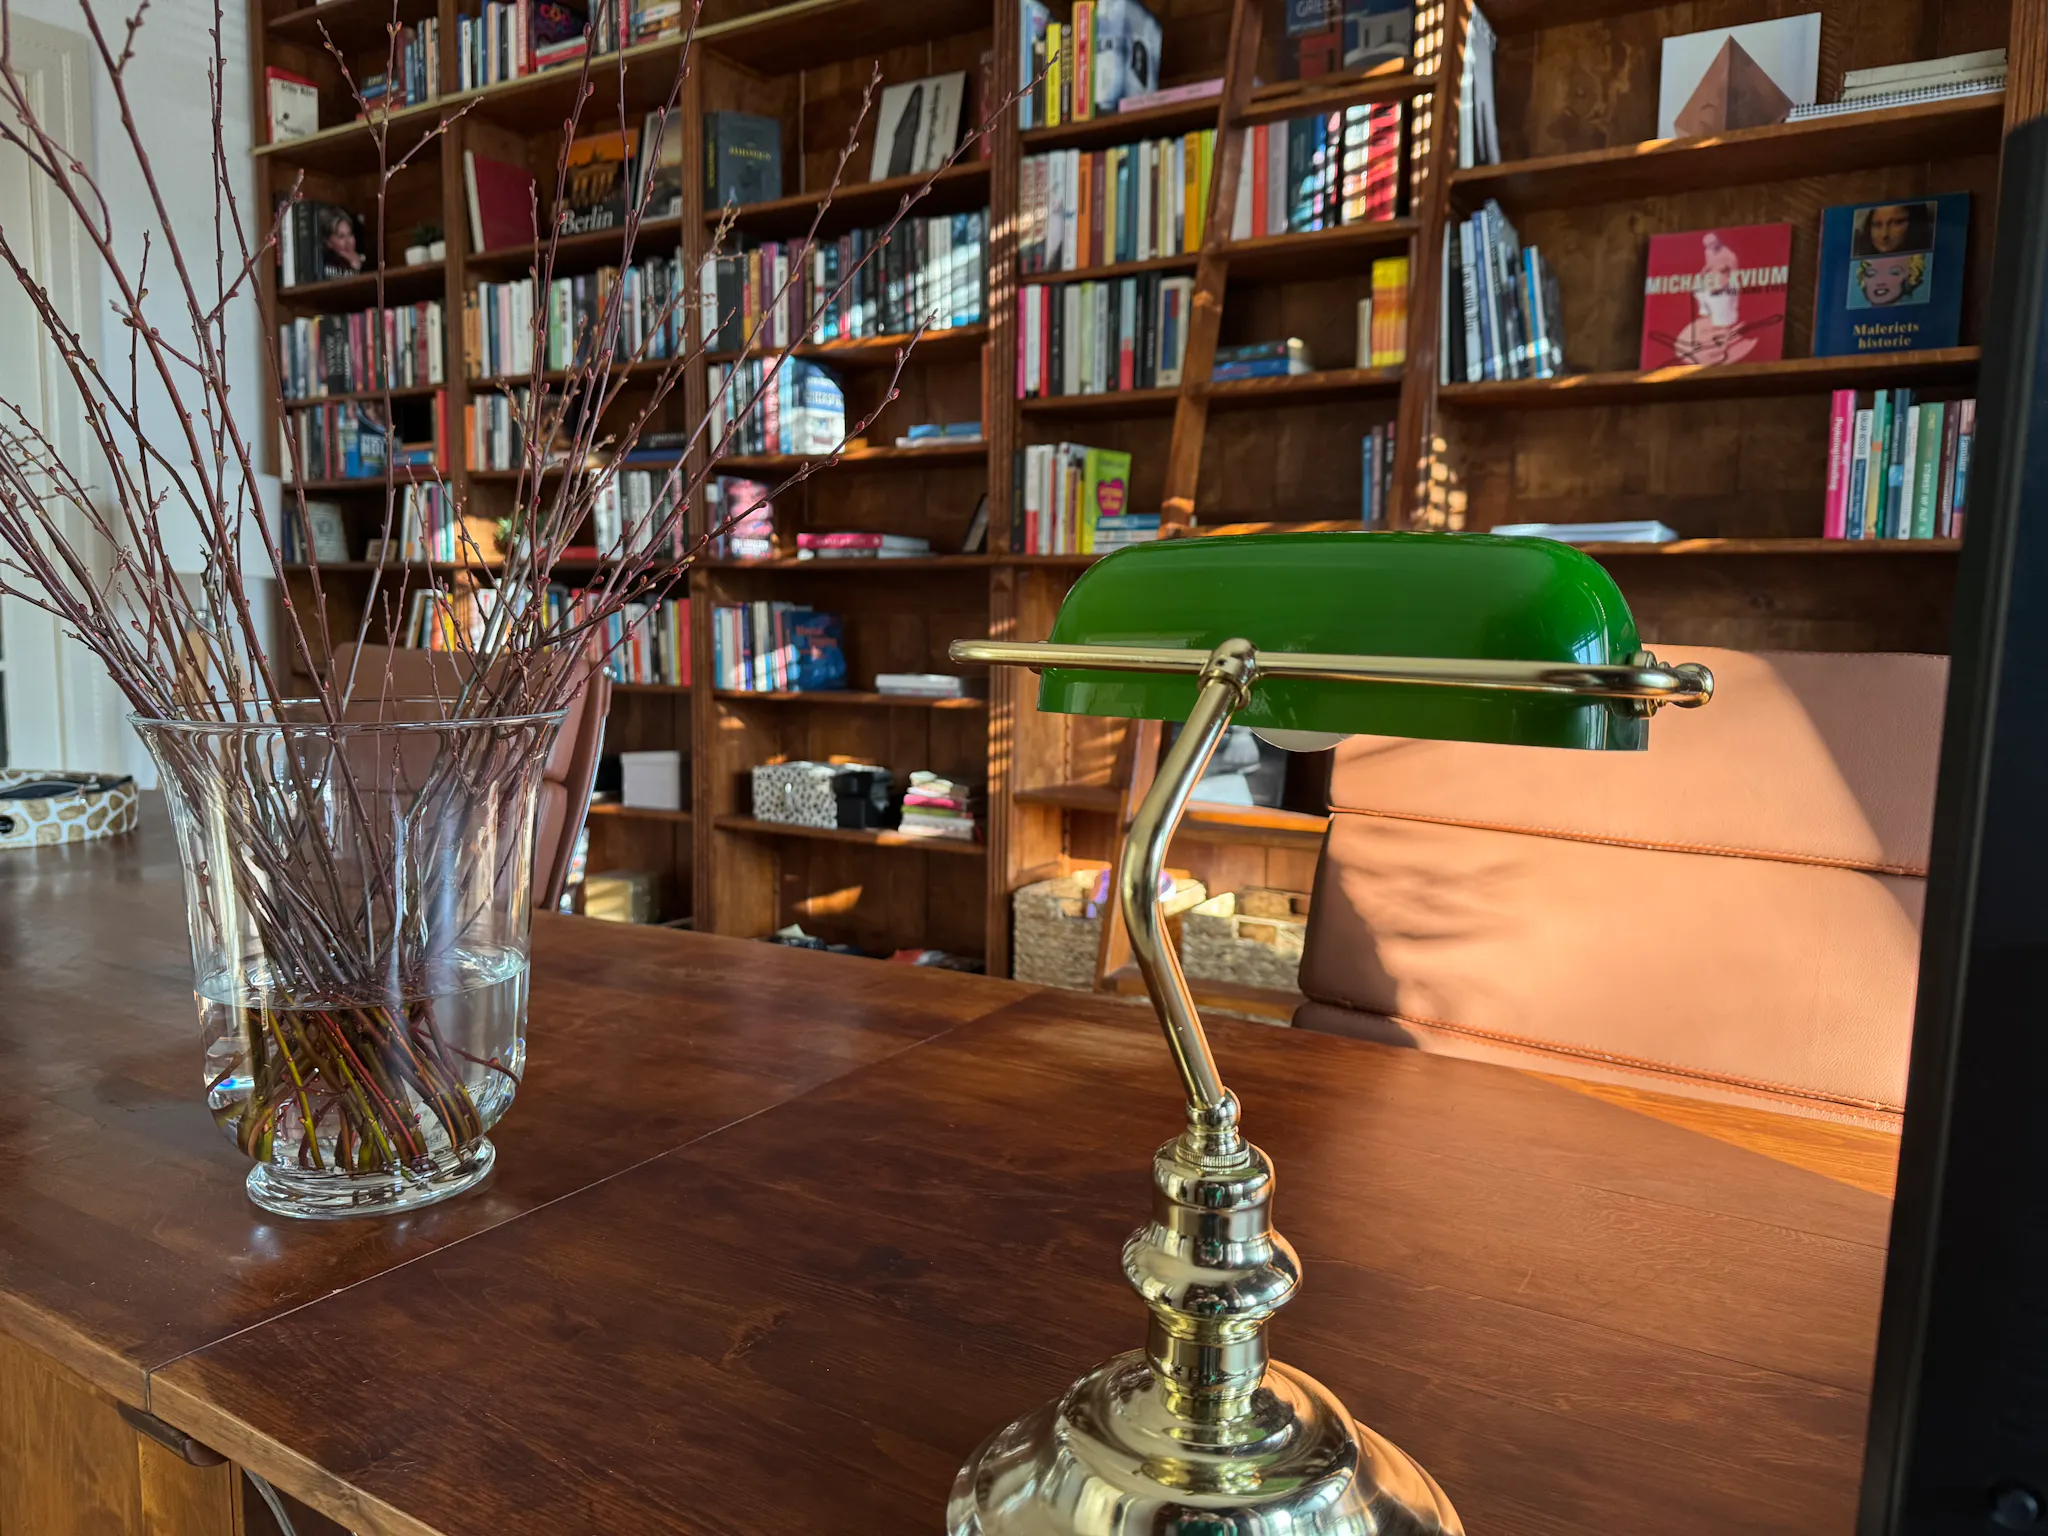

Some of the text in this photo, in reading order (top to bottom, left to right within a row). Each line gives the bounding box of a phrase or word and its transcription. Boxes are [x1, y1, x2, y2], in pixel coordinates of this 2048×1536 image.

[560, 204, 614, 236] Berlin
[1645, 265, 1789, 295] MICHAEL KVIUM
[1852, 320, 1920, 337] Maleriets
[1858, 334, 1912, 350] historie
